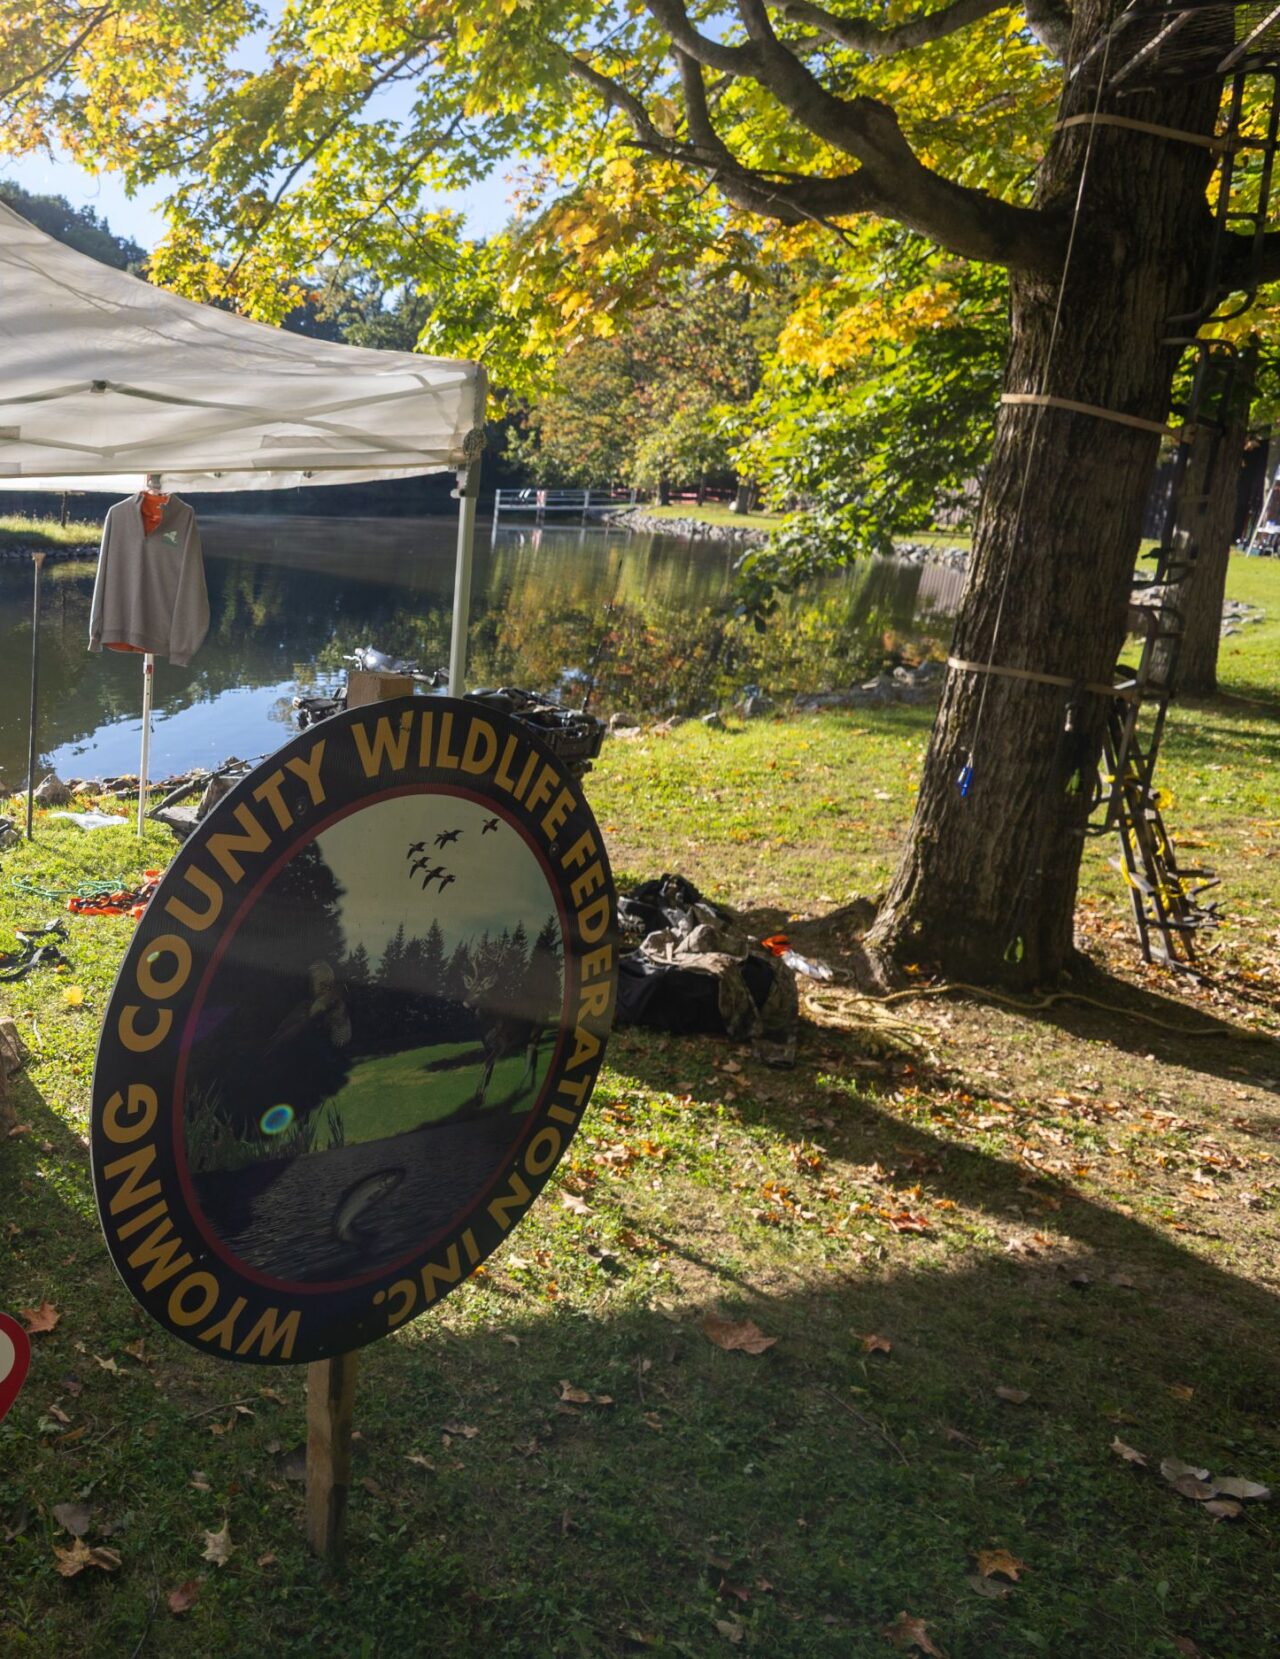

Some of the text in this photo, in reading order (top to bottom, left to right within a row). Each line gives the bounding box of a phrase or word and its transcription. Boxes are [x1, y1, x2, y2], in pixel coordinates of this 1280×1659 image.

[103, 710, 612, 1359] WYOMING COUNTY WILDLIFE FEDERATION INC.
